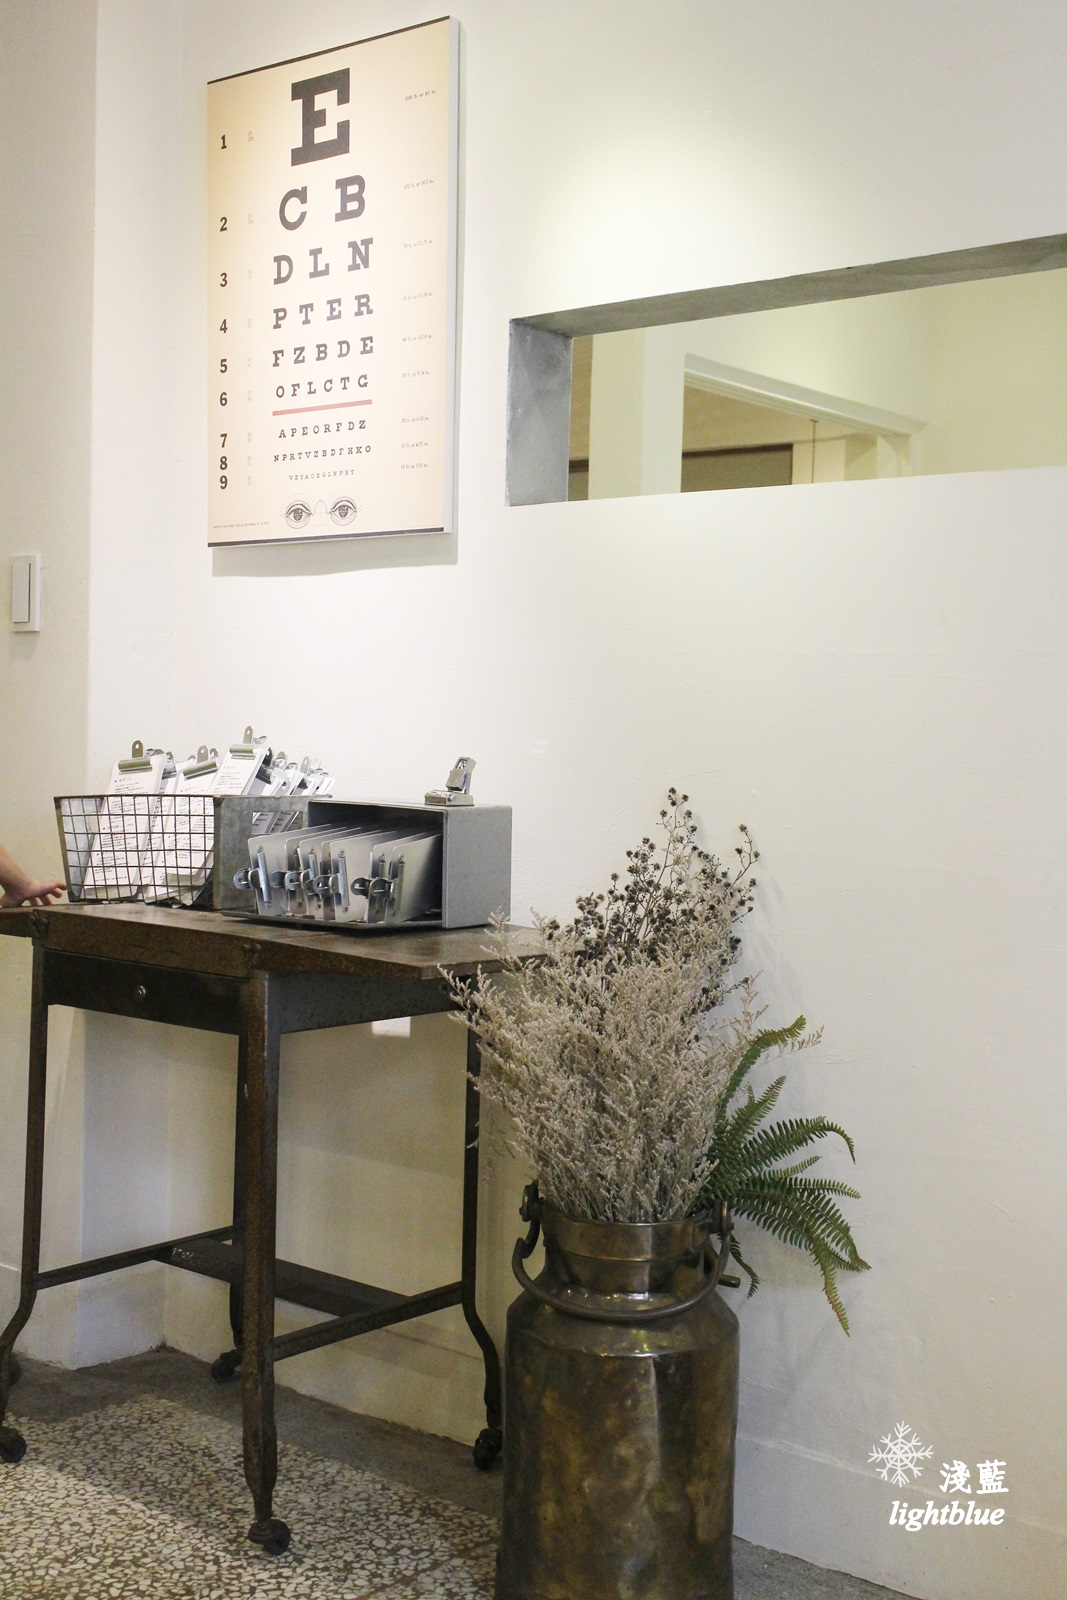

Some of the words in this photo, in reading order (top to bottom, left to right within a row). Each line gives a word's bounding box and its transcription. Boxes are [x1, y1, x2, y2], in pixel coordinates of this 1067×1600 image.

[290, 67, 351, 167] E
[220, 134, 228, 150] 1
[219, 216, 228, 232] 2
[219, 272, 228, 288] 3
[219, 318, 229, 334] 4
[219, 358, 228, 374] 5
[219, 391, 228, 407] 6
[219, 432, 228, 449] 7
[219, 455, 228, 471] 8
[219, 474, 229, 490] 9
